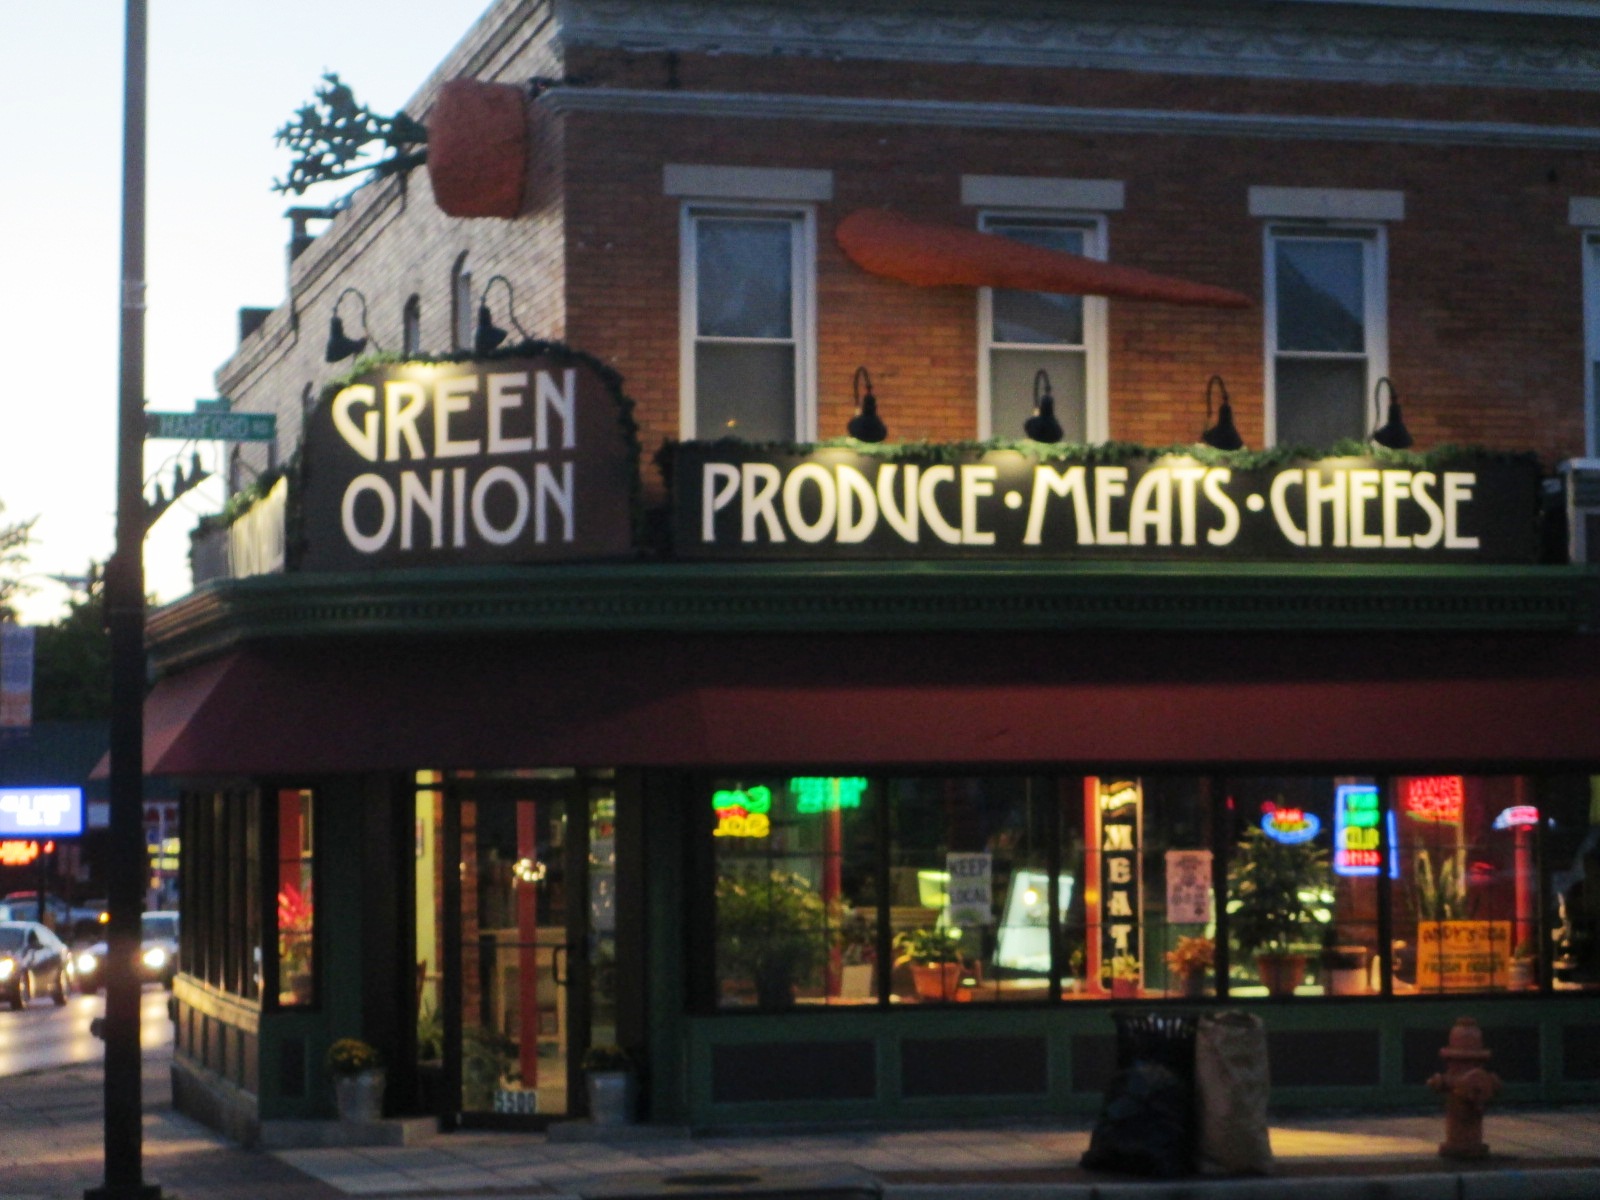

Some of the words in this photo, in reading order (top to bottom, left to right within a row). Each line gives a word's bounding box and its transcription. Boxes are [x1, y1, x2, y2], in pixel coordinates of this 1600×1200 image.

[330, 368, 577, 462] GREEN
[340, 462, 575, 553] ONION
[702, 462, 997, 545] PRODUCE
[1023, 465, 1240, 546] MEATS
[1270, 468, 1480, 549] CHEESE
